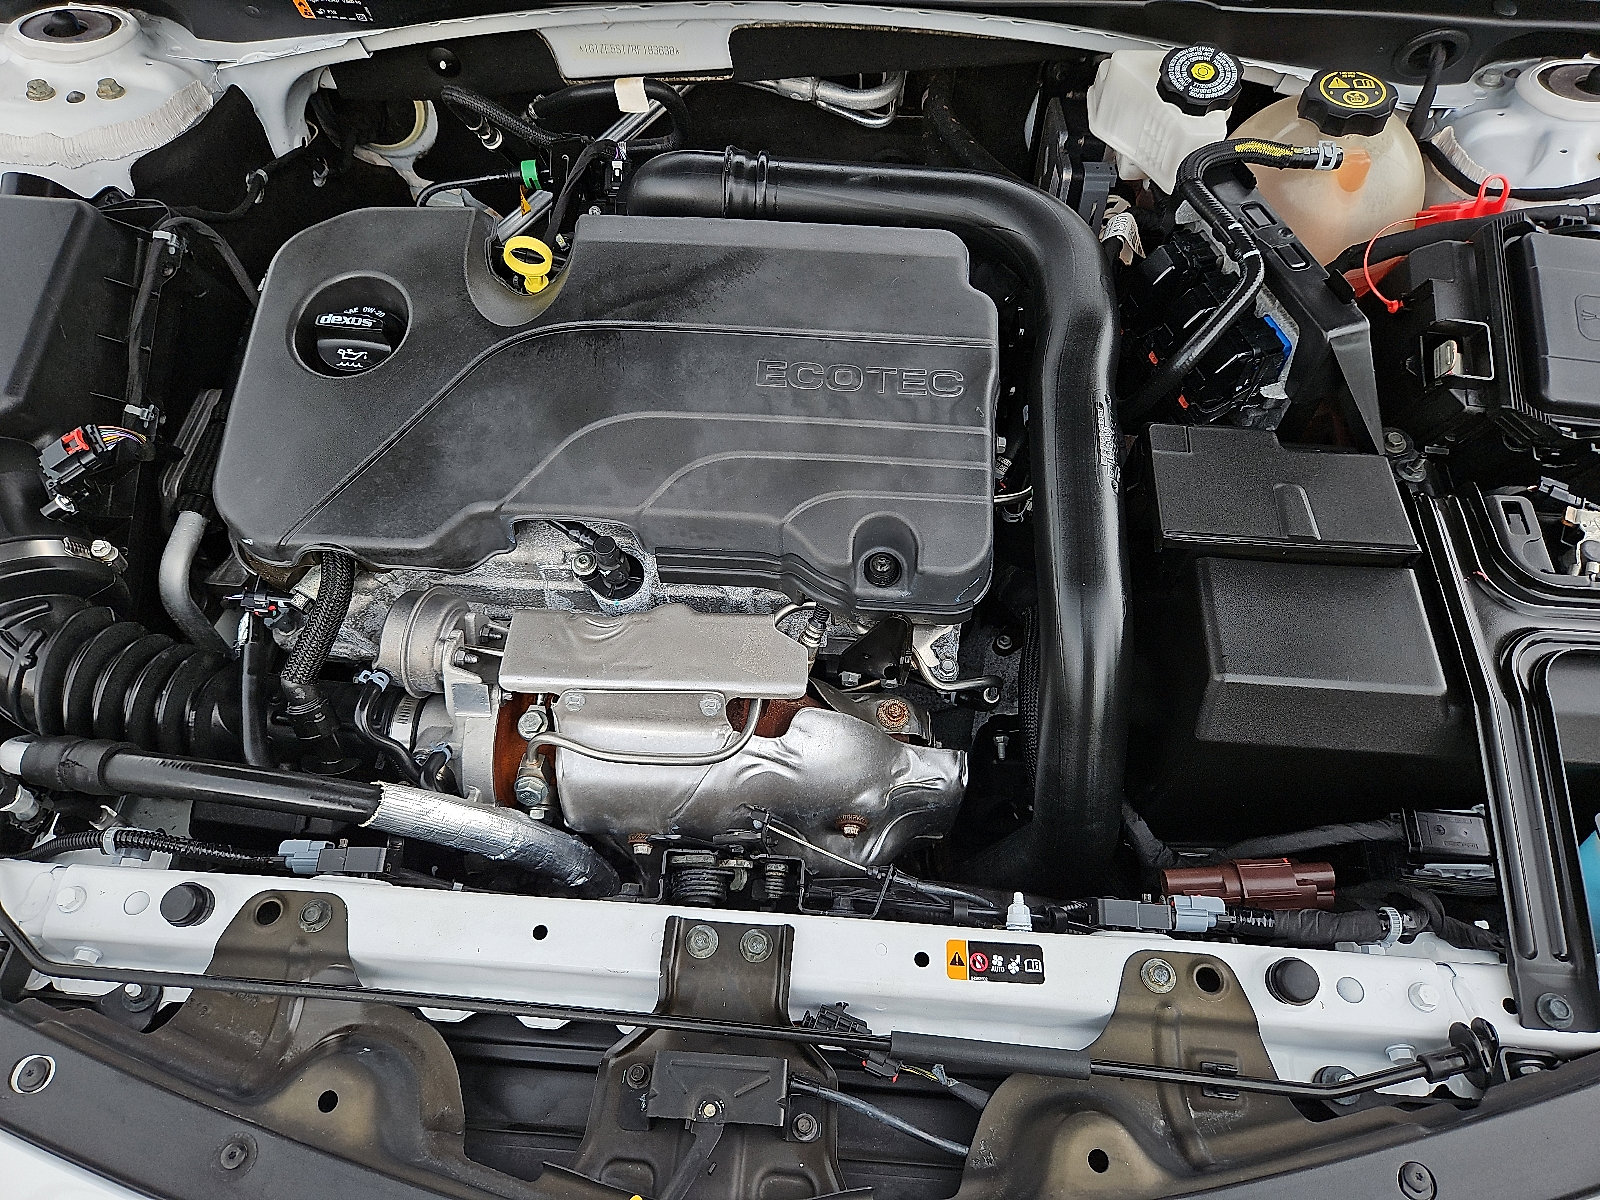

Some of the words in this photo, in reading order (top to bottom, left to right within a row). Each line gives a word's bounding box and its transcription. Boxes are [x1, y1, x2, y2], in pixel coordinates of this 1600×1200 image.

[362, 306, 386, 318] 0W-20
[319, 313, 373, 326] dexos
[755, 359, 965, 398] ECOTEC
[991, 965, 1005, 973] AUTO
